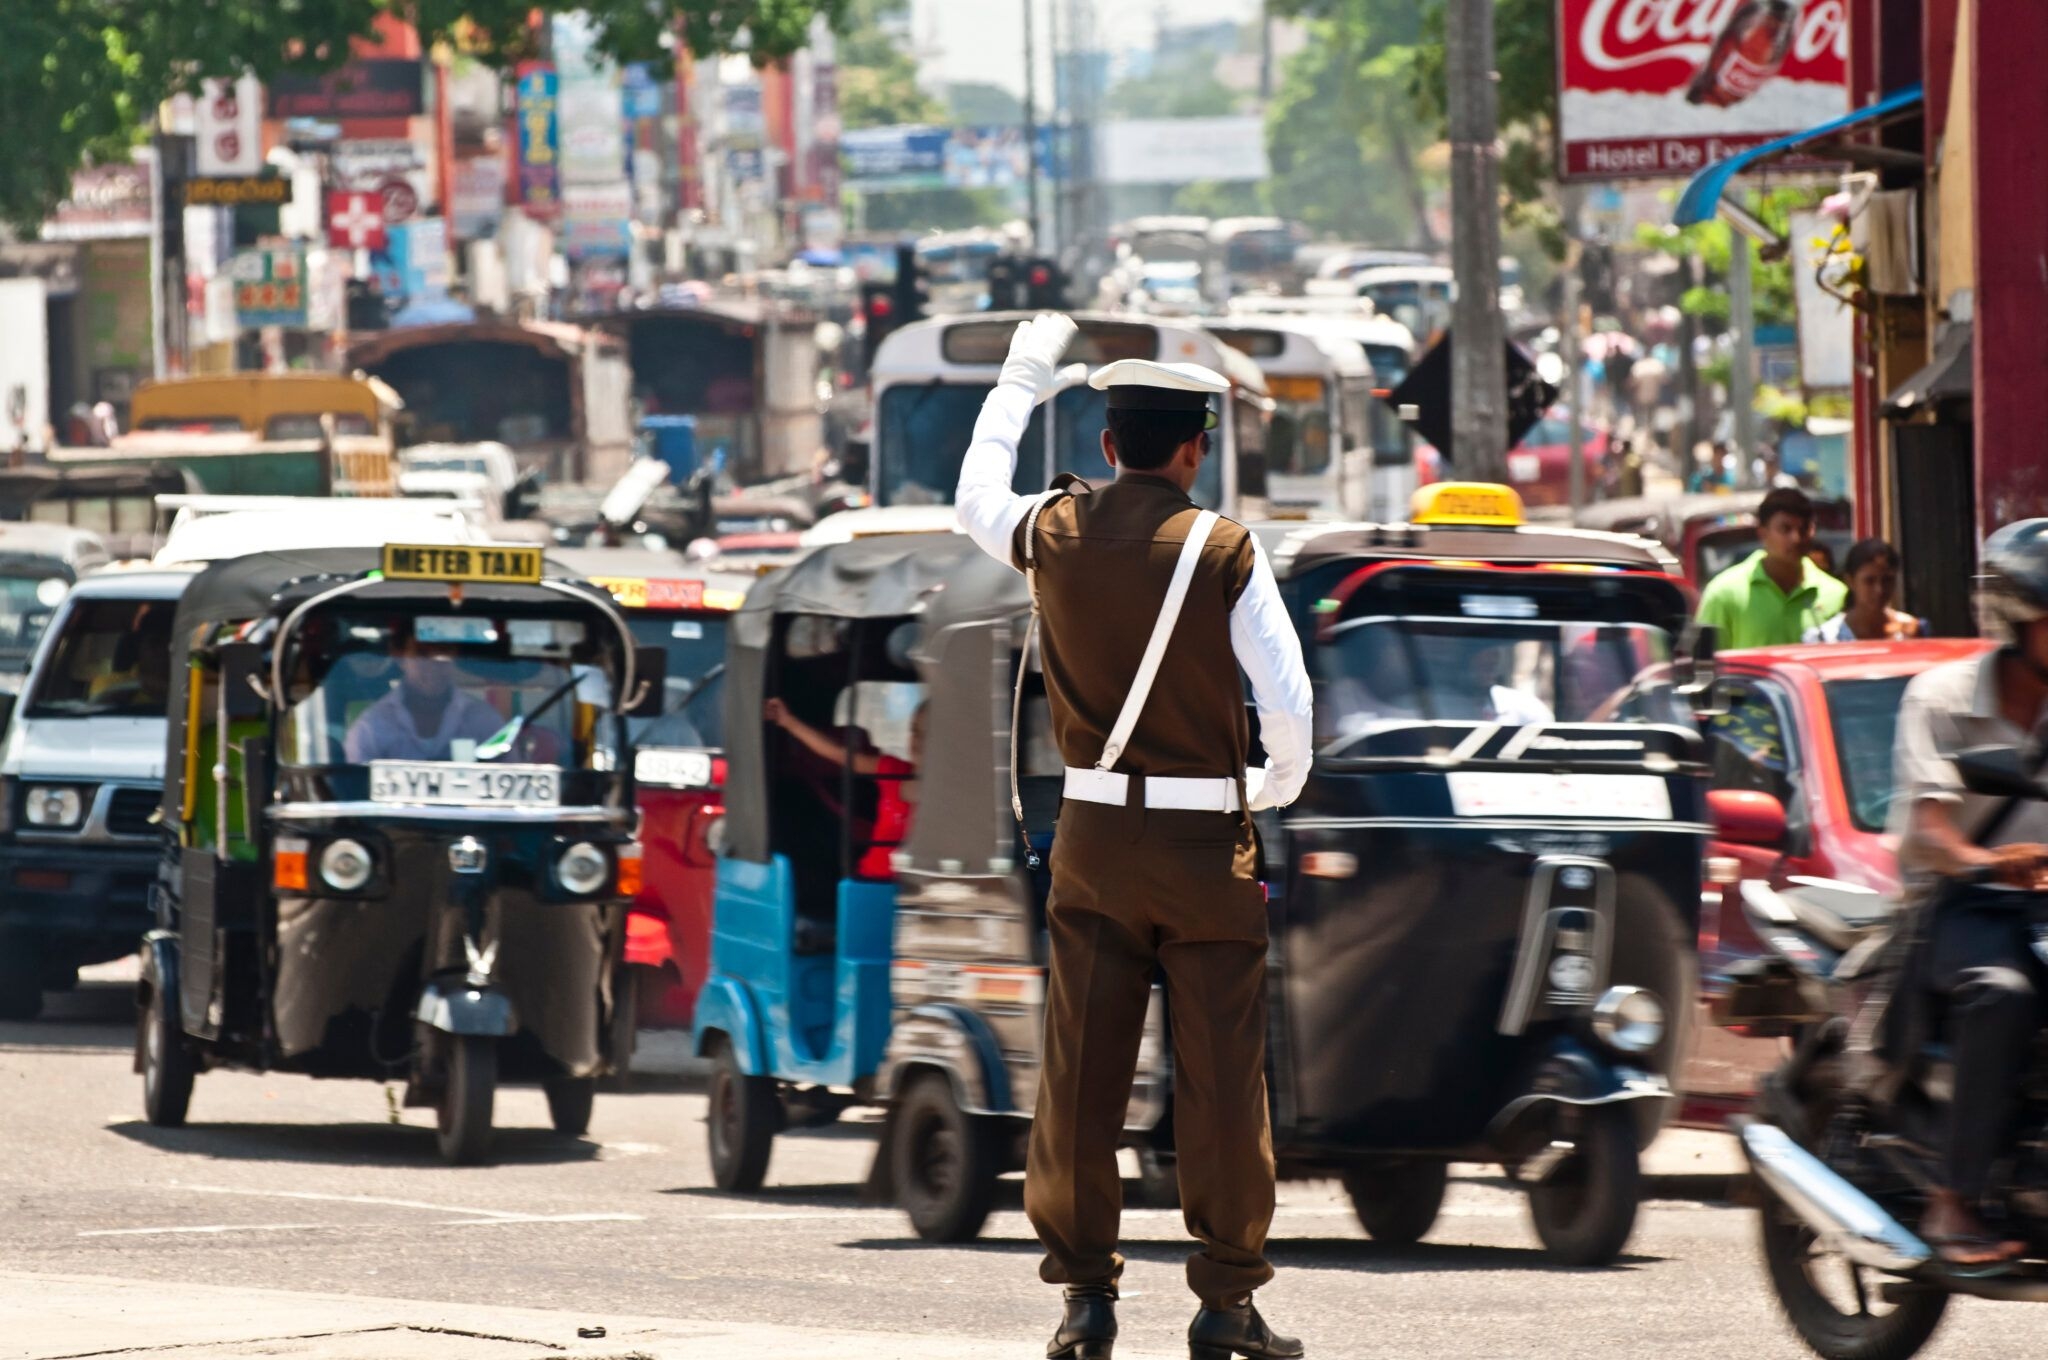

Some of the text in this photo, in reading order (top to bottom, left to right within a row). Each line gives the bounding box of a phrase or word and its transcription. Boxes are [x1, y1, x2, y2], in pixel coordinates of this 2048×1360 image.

[1587, 144, 1658, 170] Hotel
[1664, 142, 1703, 168] De
[392, 548, 535, 577] METER TAXI
